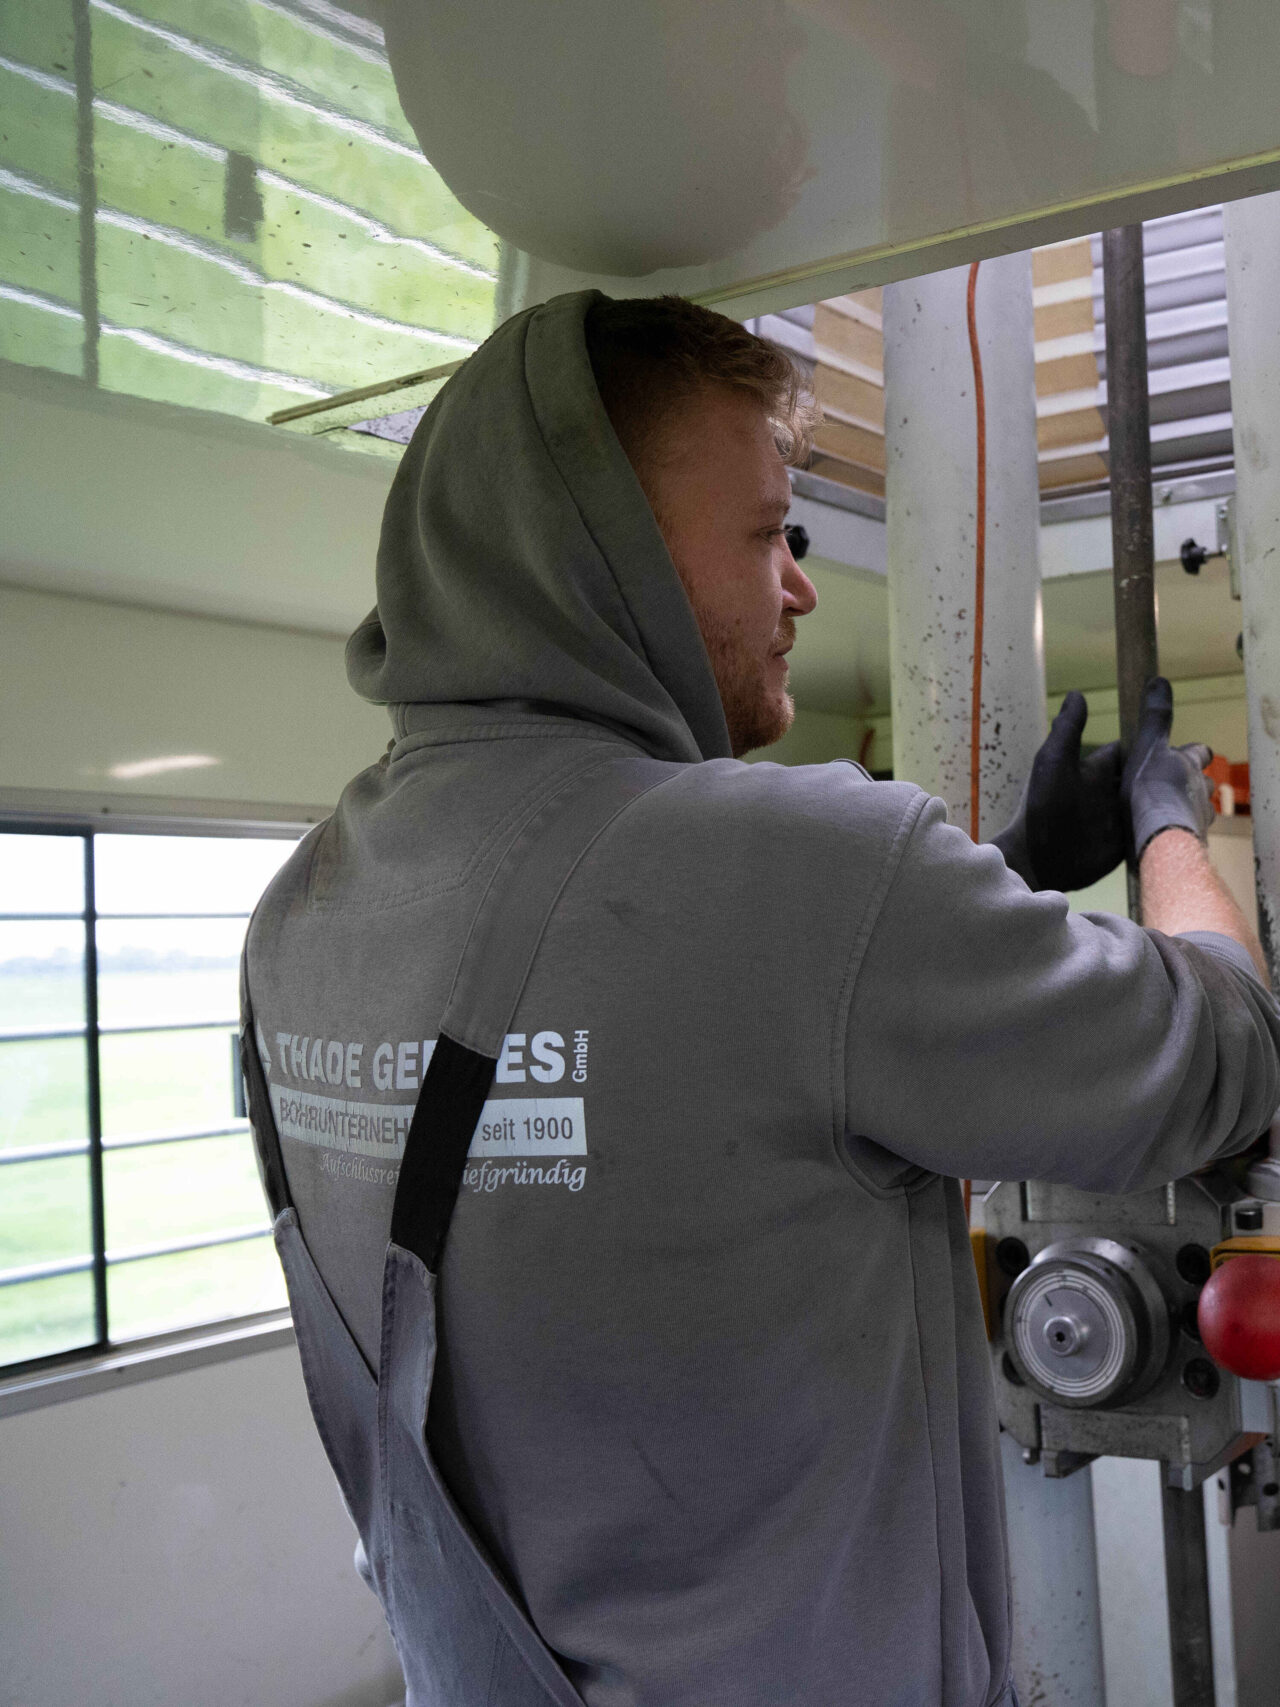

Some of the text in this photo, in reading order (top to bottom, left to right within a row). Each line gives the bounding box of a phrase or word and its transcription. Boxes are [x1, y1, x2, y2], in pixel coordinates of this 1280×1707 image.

[276, 1030, 590, 1091] THADE GEES GmbH
[280, 1097, 574, 1145] BOHRUNTERNEH seit 1900
[320, 1151, 588, 1192] Aufschlussrei iefgründig
